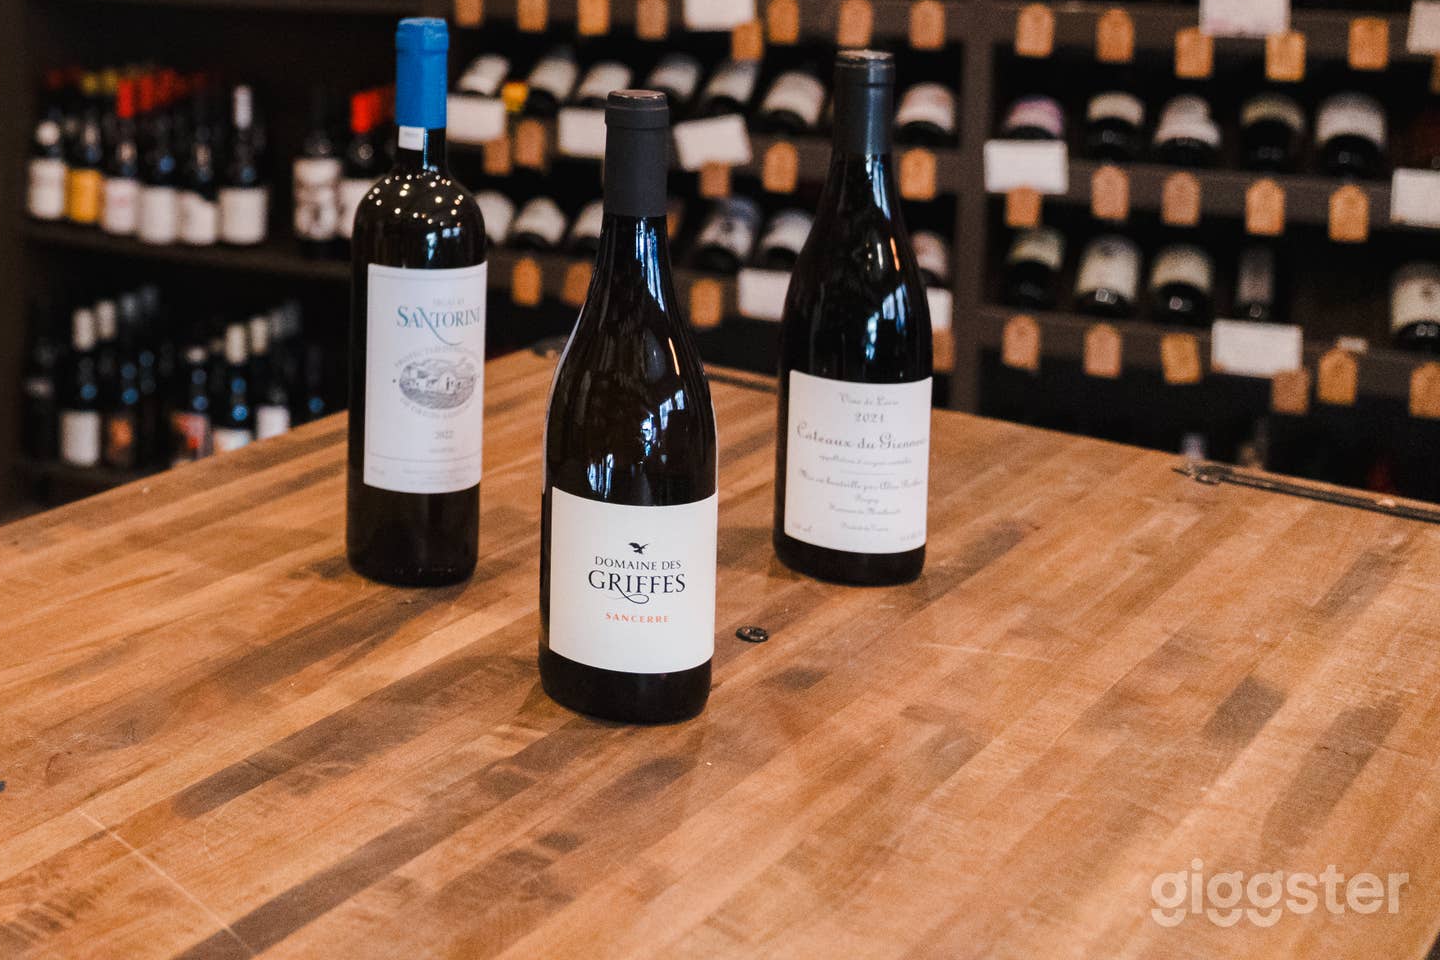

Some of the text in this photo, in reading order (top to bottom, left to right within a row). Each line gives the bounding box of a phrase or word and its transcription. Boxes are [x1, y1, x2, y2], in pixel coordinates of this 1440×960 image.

[797, 422, 854, 448] Coteaux
[857, 436, 875, 449] du
[594, 555, 681, 571] DOMAINE DES
[588, 570, 686, 604] GRIFFES
[605, 612, 669, 624] SANCERRE
